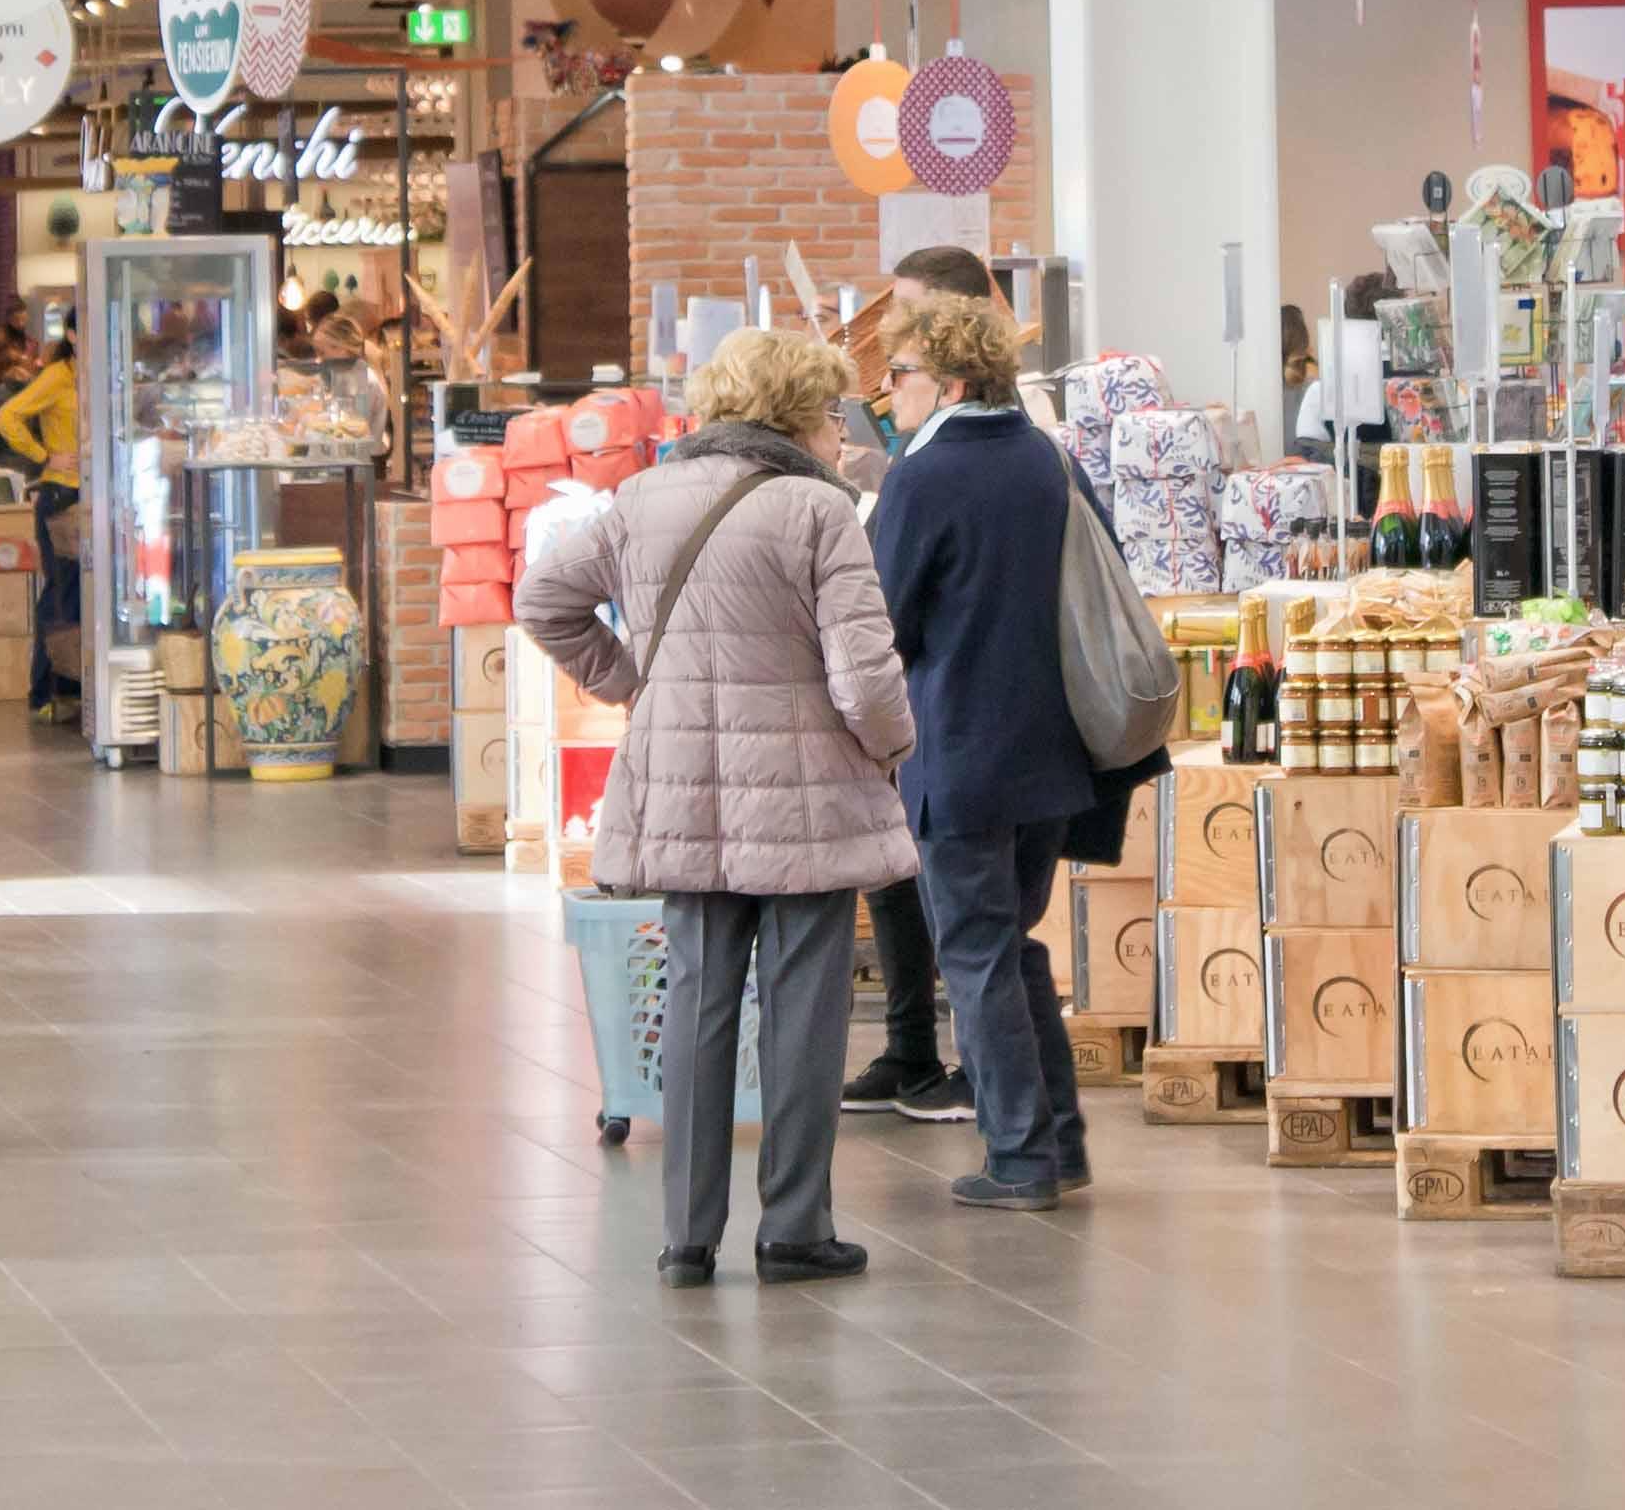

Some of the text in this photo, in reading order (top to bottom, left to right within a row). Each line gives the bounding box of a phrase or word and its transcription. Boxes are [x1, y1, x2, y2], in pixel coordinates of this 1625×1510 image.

[1161, 1079, 1198, 1100] EPAL
[1289, 1115, 1328, 1139] EPAL
[1414, 1176, 1456, 1198] EPAL
